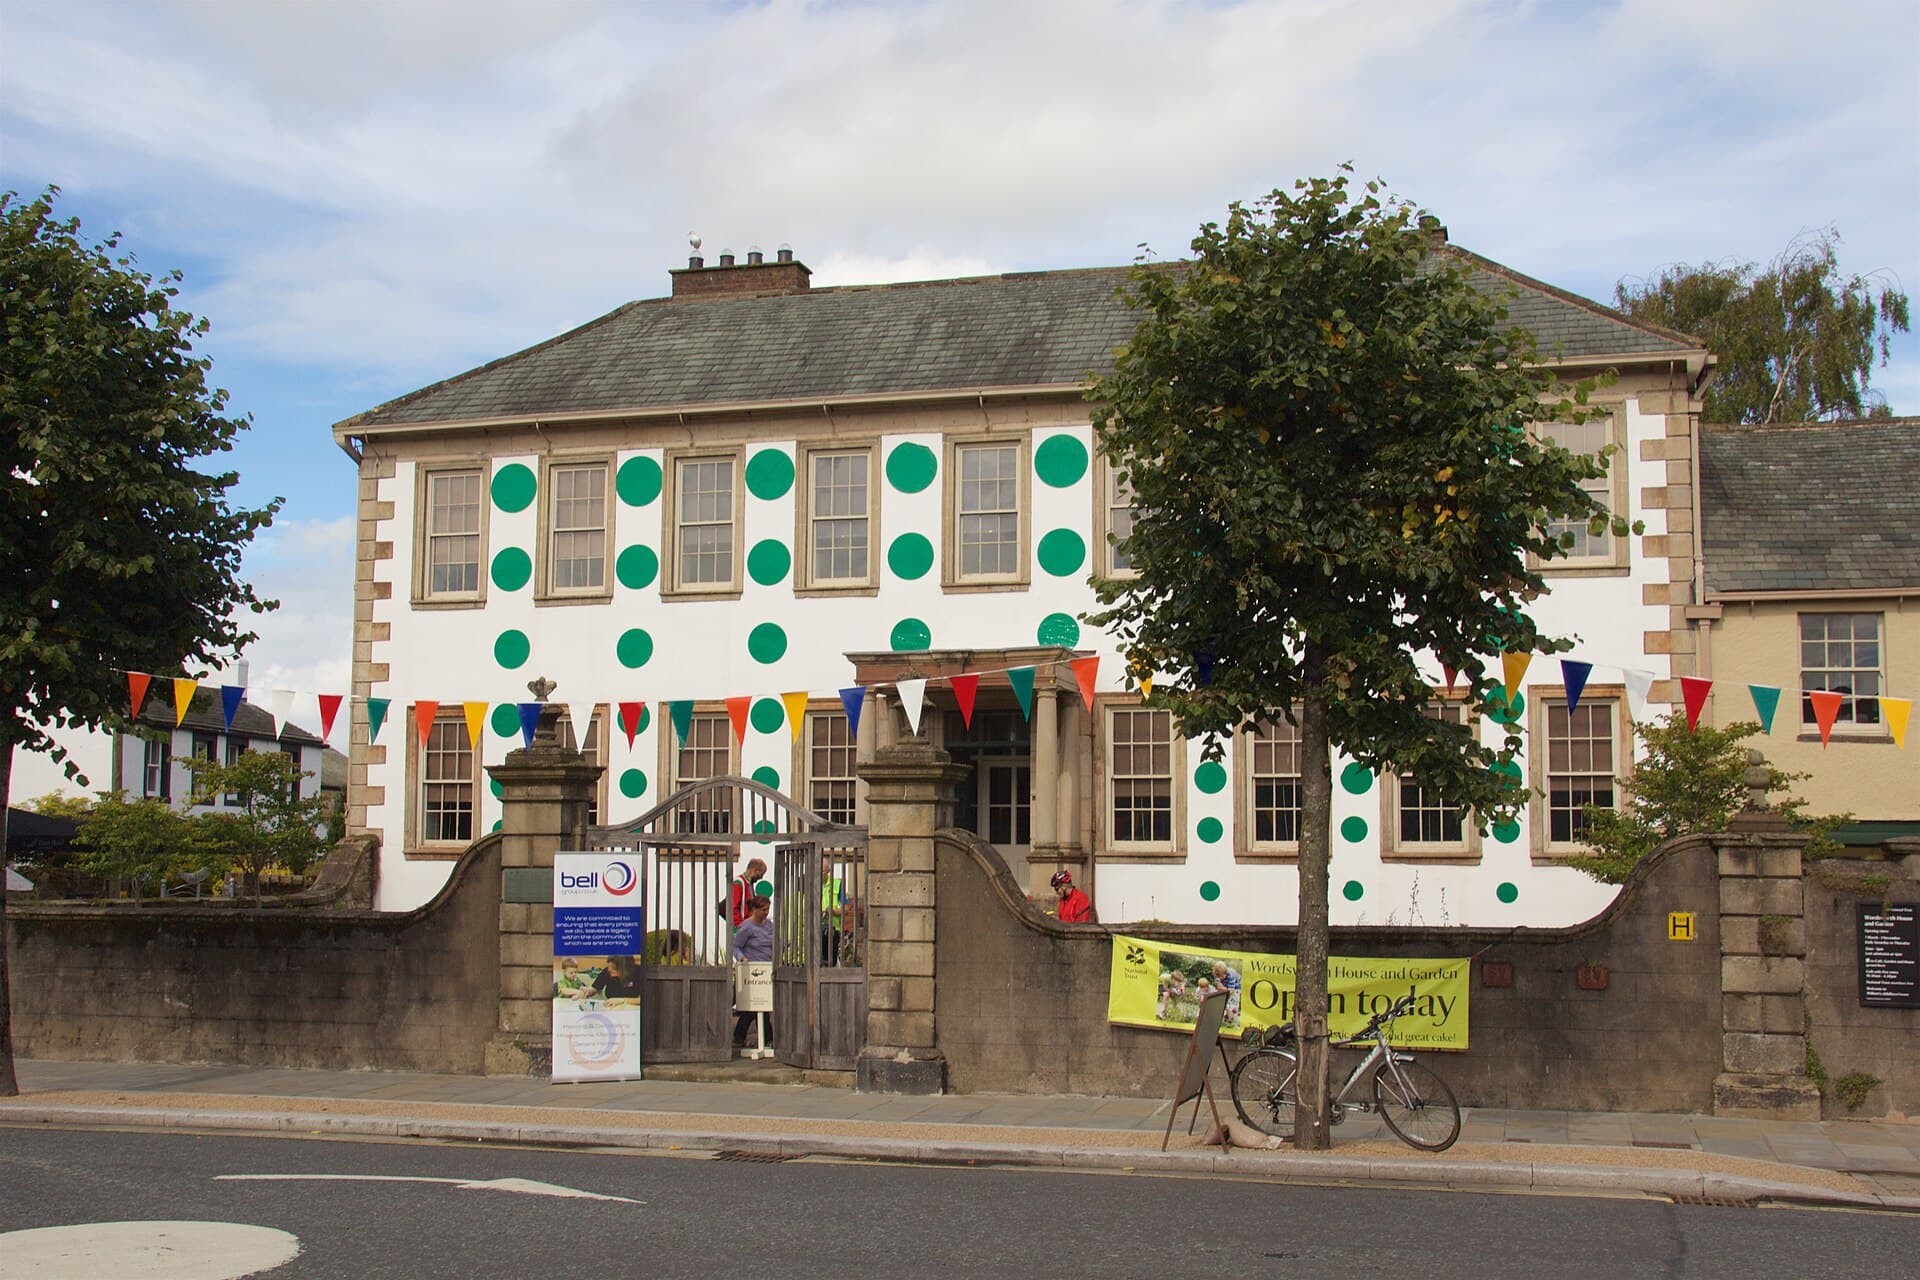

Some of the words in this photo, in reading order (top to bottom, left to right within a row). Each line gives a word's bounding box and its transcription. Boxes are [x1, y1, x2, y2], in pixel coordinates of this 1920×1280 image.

[561, 872, 598, 888] bell
[1673, 916, 1689, 937] H
[1335, 966, 1377, 979] House
[1380, 966, 1406, 980] and
[1409, 967, 1458, 980] Garden
[1250, 979, 1345, 1020] Opn
[1357, 985, 1457, 1027] today
[1405, 1033, 1429, 1045] great
[1431, 1032, 1456, 1042] cake!
